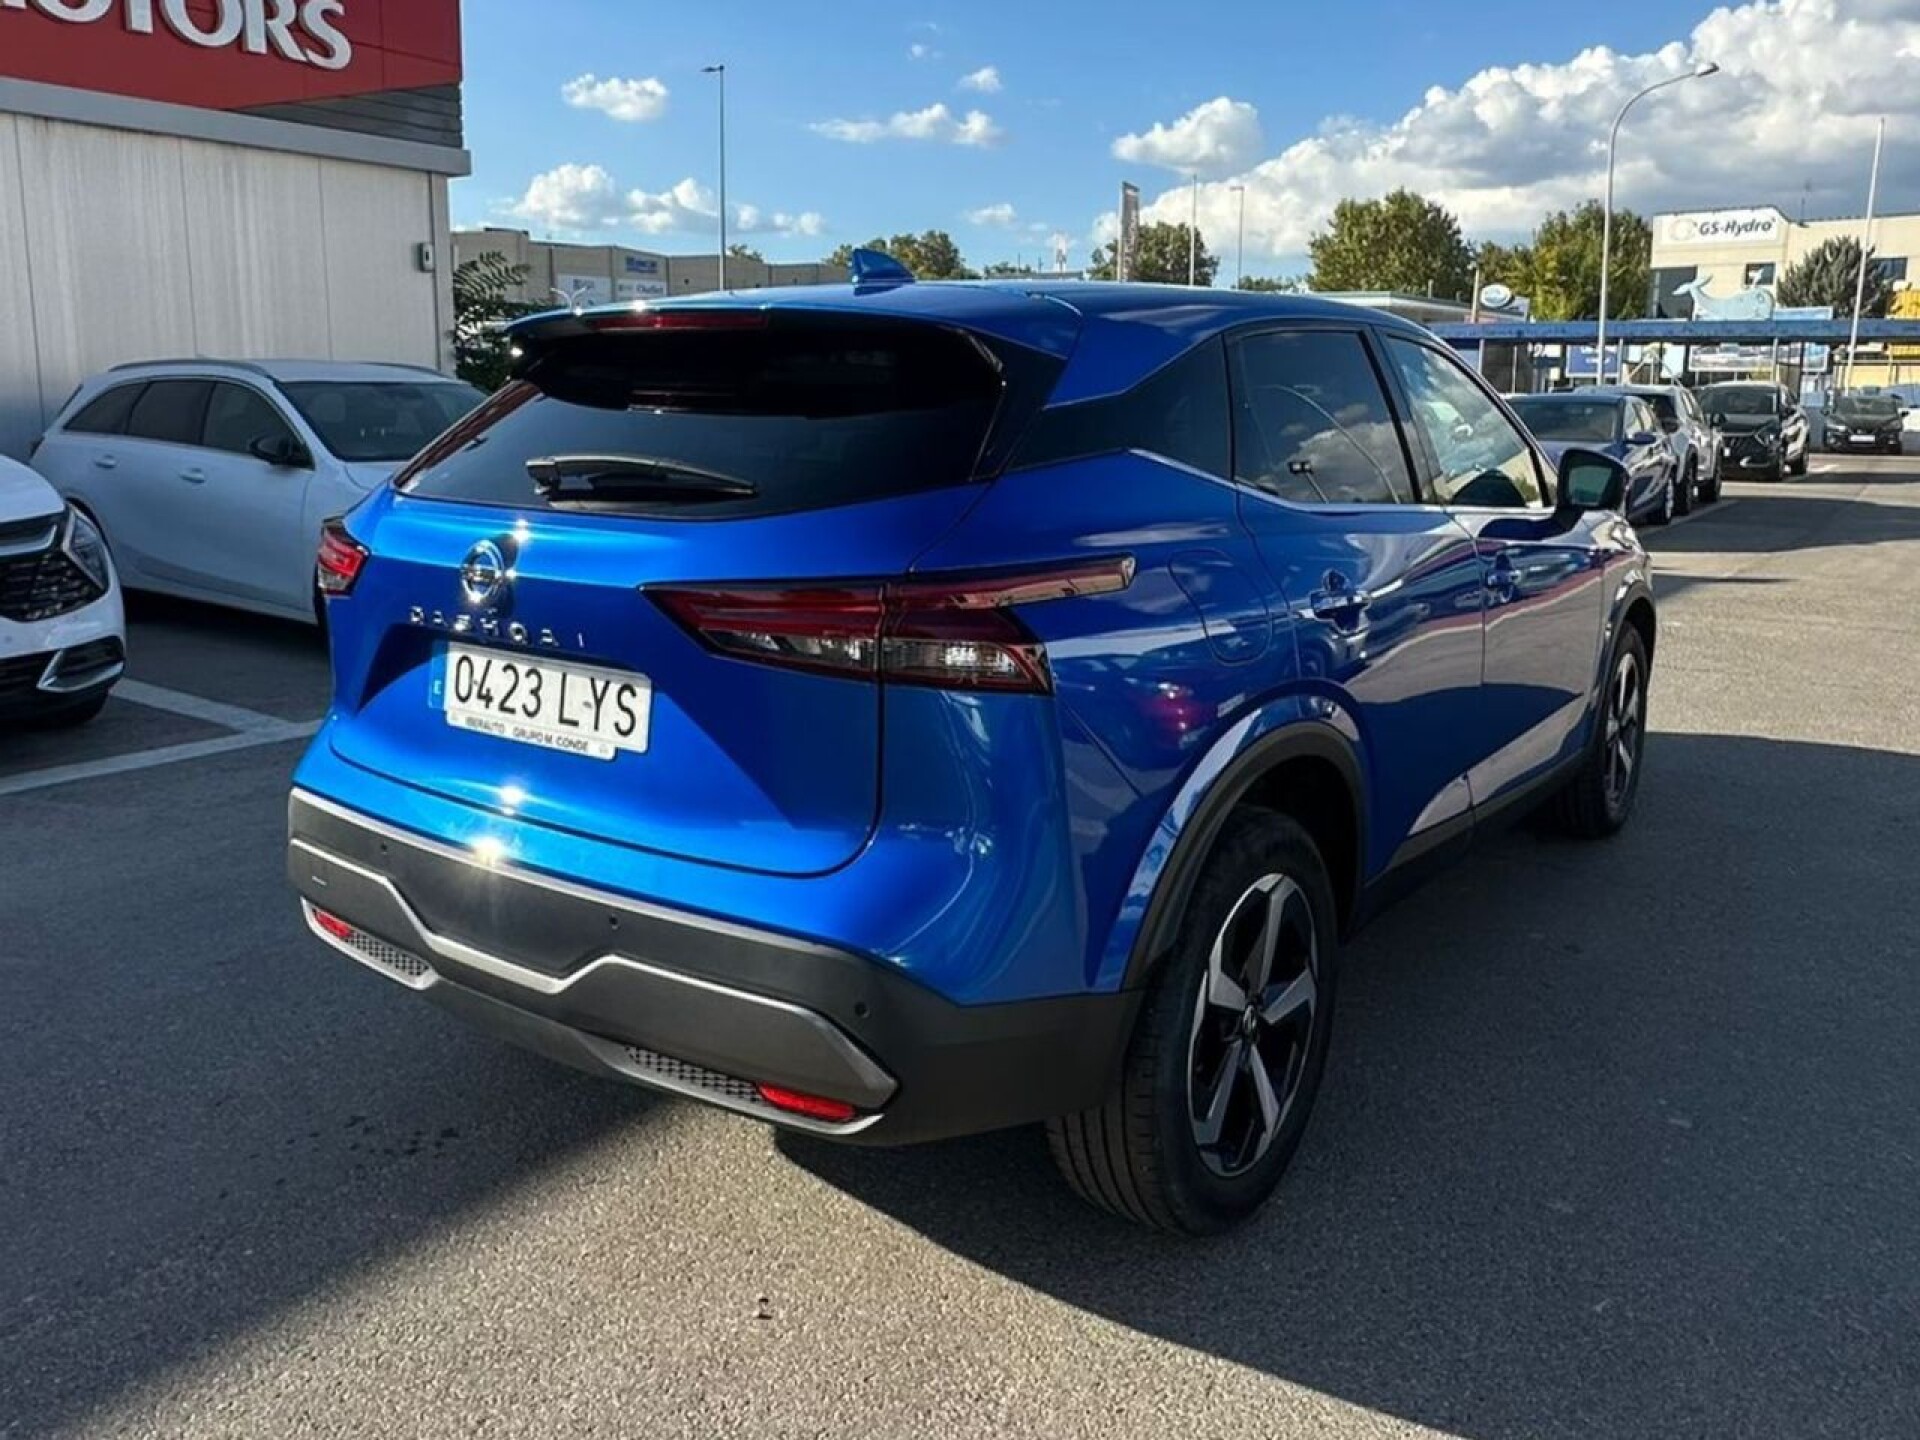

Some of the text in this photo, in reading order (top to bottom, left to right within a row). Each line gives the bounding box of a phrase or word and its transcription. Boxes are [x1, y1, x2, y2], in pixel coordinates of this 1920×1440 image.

[1699, 218, 1773, 237] GS-Hydro
[455, 655, 637, 737] 0423 LYS
[556, 735, 589, 750] CONDE
